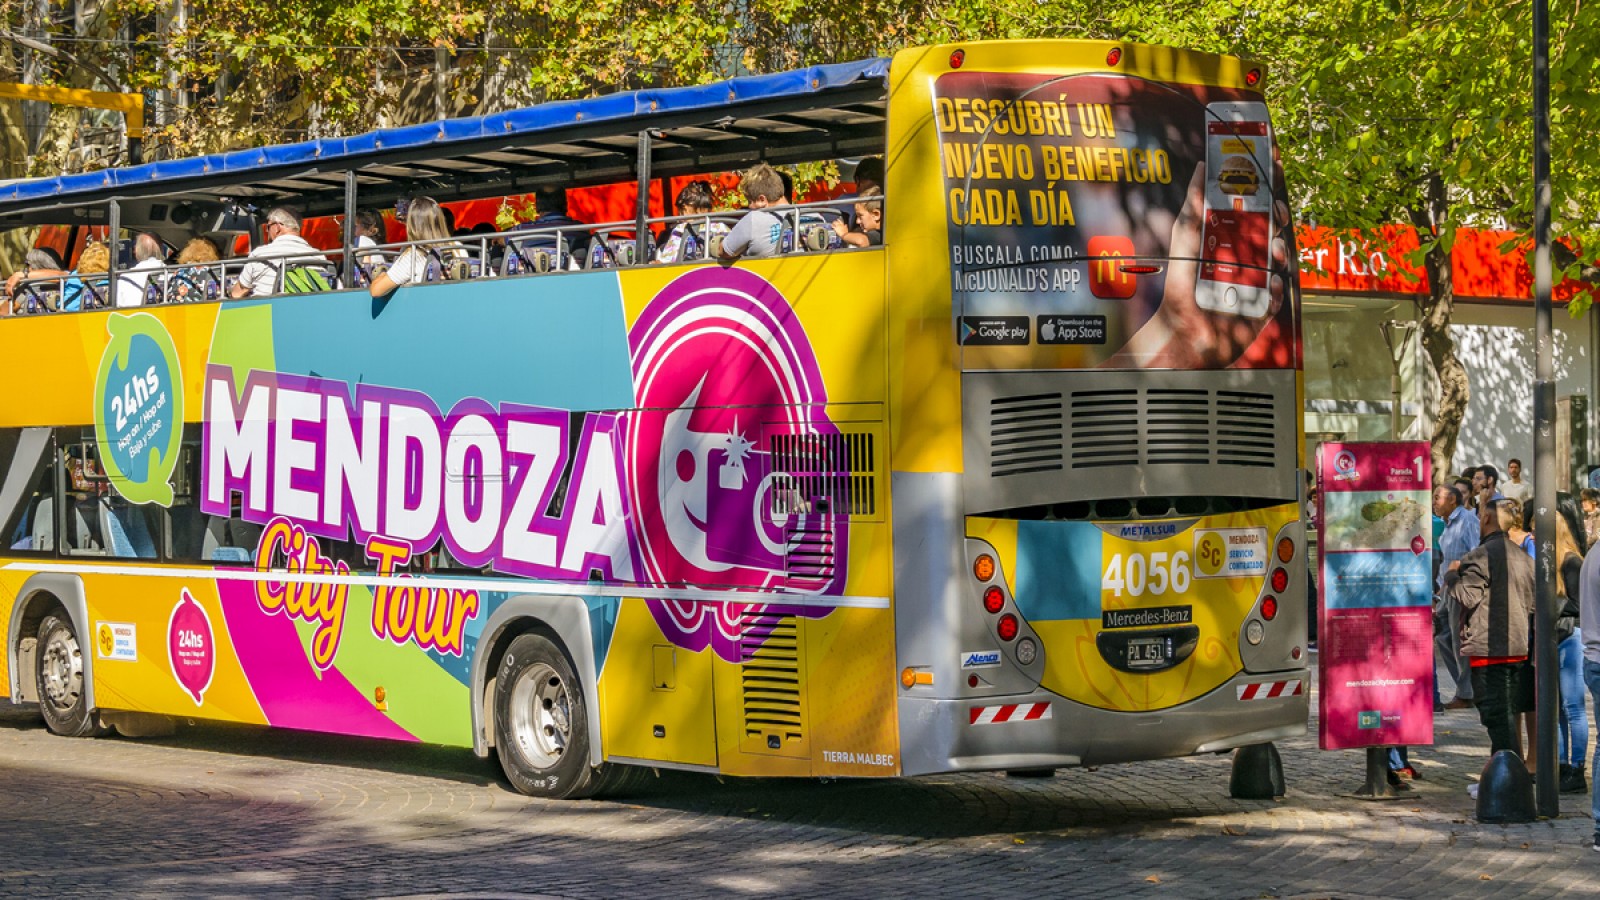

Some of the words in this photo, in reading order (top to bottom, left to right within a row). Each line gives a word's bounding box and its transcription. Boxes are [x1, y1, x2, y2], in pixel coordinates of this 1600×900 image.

[939, 94, 1073, 137] DESCUBRÍ
[1077, 102, 1116, 138] UN
[943, 143, 1034, 181] NUEVO
[1042, 144, 1172, 185] BENEFICIO
[950, 188, 1023, 226] CADA
[1031, 182, 1076, 227] DÍA
[953, 245, 1024, 265] BUSCALA
[1053, 268, 1081, 292] APP
[979, 326, 1009, 340] Google
[1011, 326, 1028, 339] play
[1058, 326, 1078, 340] App
[1079, 326, 1102, 338] Store
[111, 365, 159, 432] 24hs
[131, 424, 140, 437] on
[143, 405, 157, 424] Hop
[129, 440, 143, 458] Baja
[142, 434, 147, 447] y
[147, 419, 161, 439] sube
[206, 376, 637, 583] MENDOZA
[1413, 456, 1424, 482] 1
[1120, 524, 1176, 537] METALSUR
[1229, 535, 1260, 545] MENDOZA
[1229, 549, 1254, 559] SERVICIO
[1102, 550, 1190, 597] 4056
[1228, 560, 1264, 571] CONTRATADO
[255, 519, 349, 667] City
[367, 538, 478, 654] Tour
[1107, 608, 1189, 627] Mercedes-Benz
[178, 629, 204, 648] 24hs
[1346, 678, 1415, 688] mendozacitytour.com
[823, 750, 856, 764] TIERRA
[857, 752, 894, 767] MALBEC
